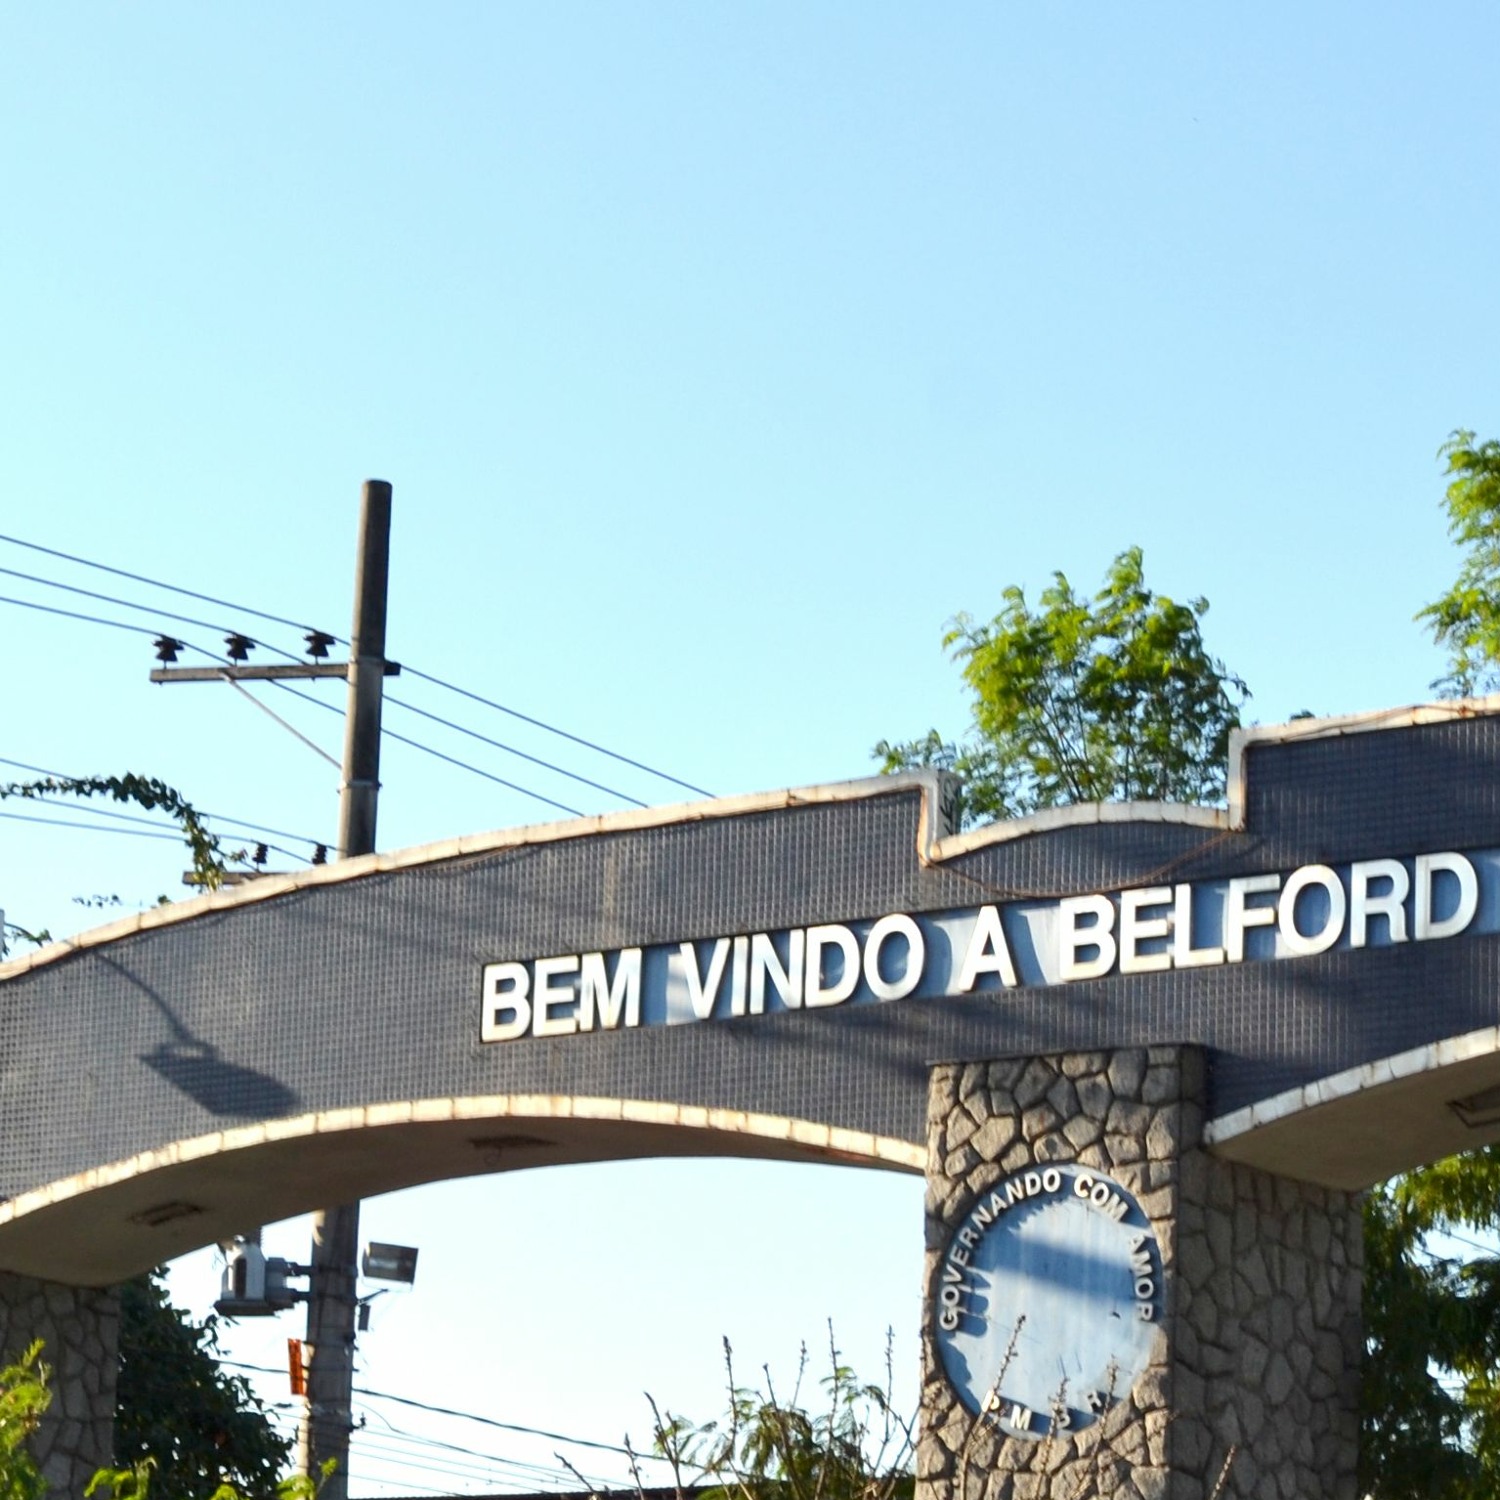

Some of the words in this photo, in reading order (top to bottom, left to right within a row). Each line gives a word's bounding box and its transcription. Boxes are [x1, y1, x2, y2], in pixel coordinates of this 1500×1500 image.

[481, 948, 642, 1043] BEM
[679, 913, 925, 1020] VINDO
[958, 905, 1019, 992] A
[1058, 852, 1478, 983] BELFORD
[940, 1168, 1060, 1330] GOVERNANDO
[1074, 1174, 1129, 1221] COM
[1130, 1234, 1154, 1322] AMOR
